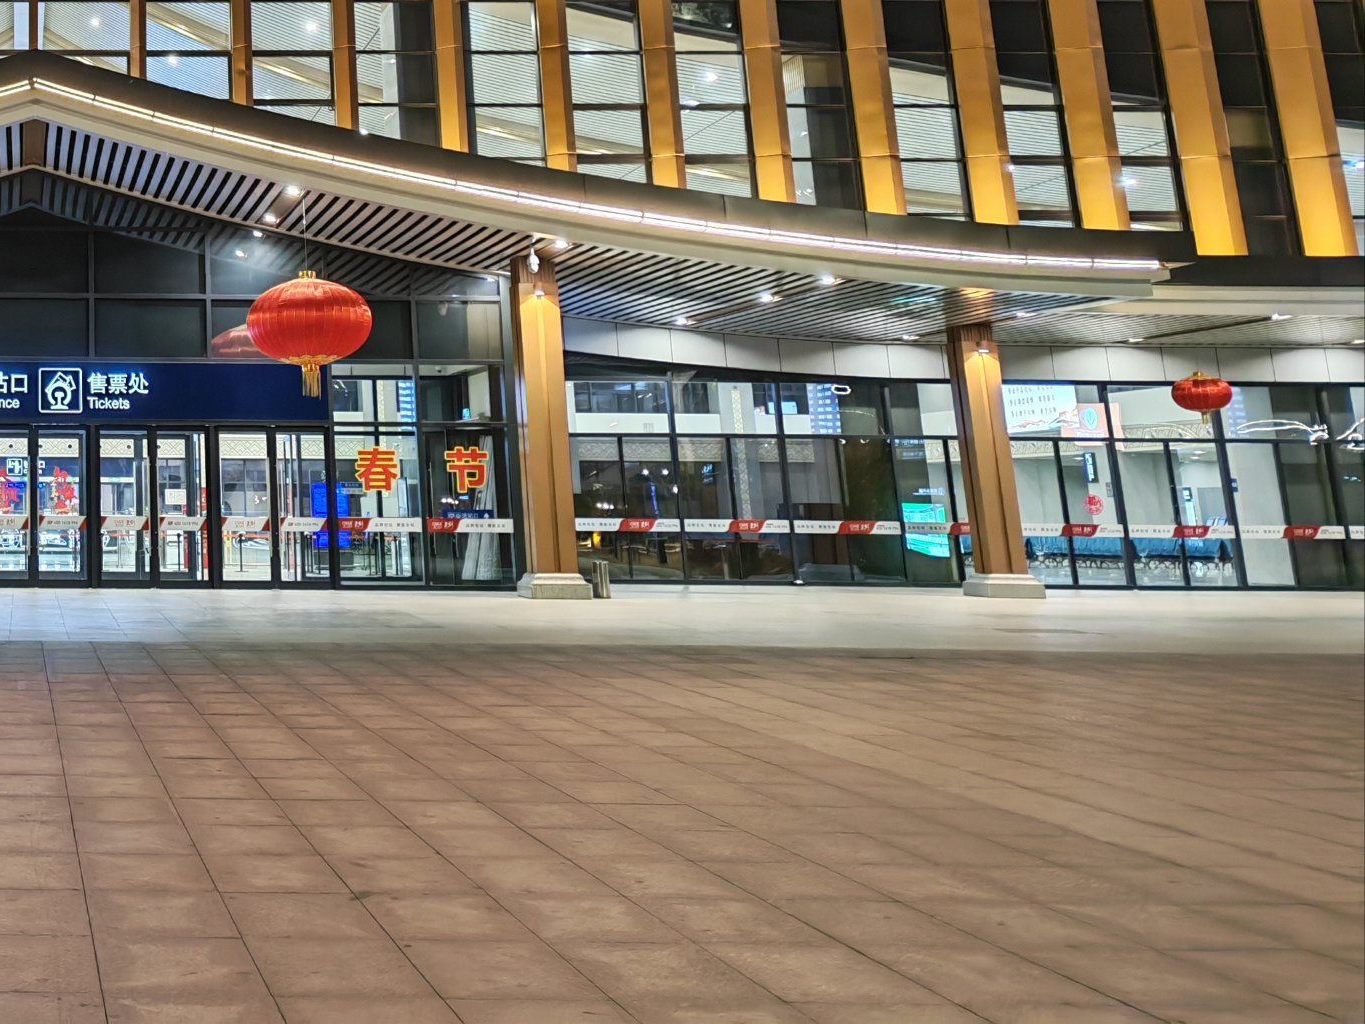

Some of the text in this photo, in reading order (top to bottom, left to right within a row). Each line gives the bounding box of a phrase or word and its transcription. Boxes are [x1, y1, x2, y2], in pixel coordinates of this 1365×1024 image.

[87, 372, 149, 394] 售票处
[87, 396, 131, 410] Tickets
